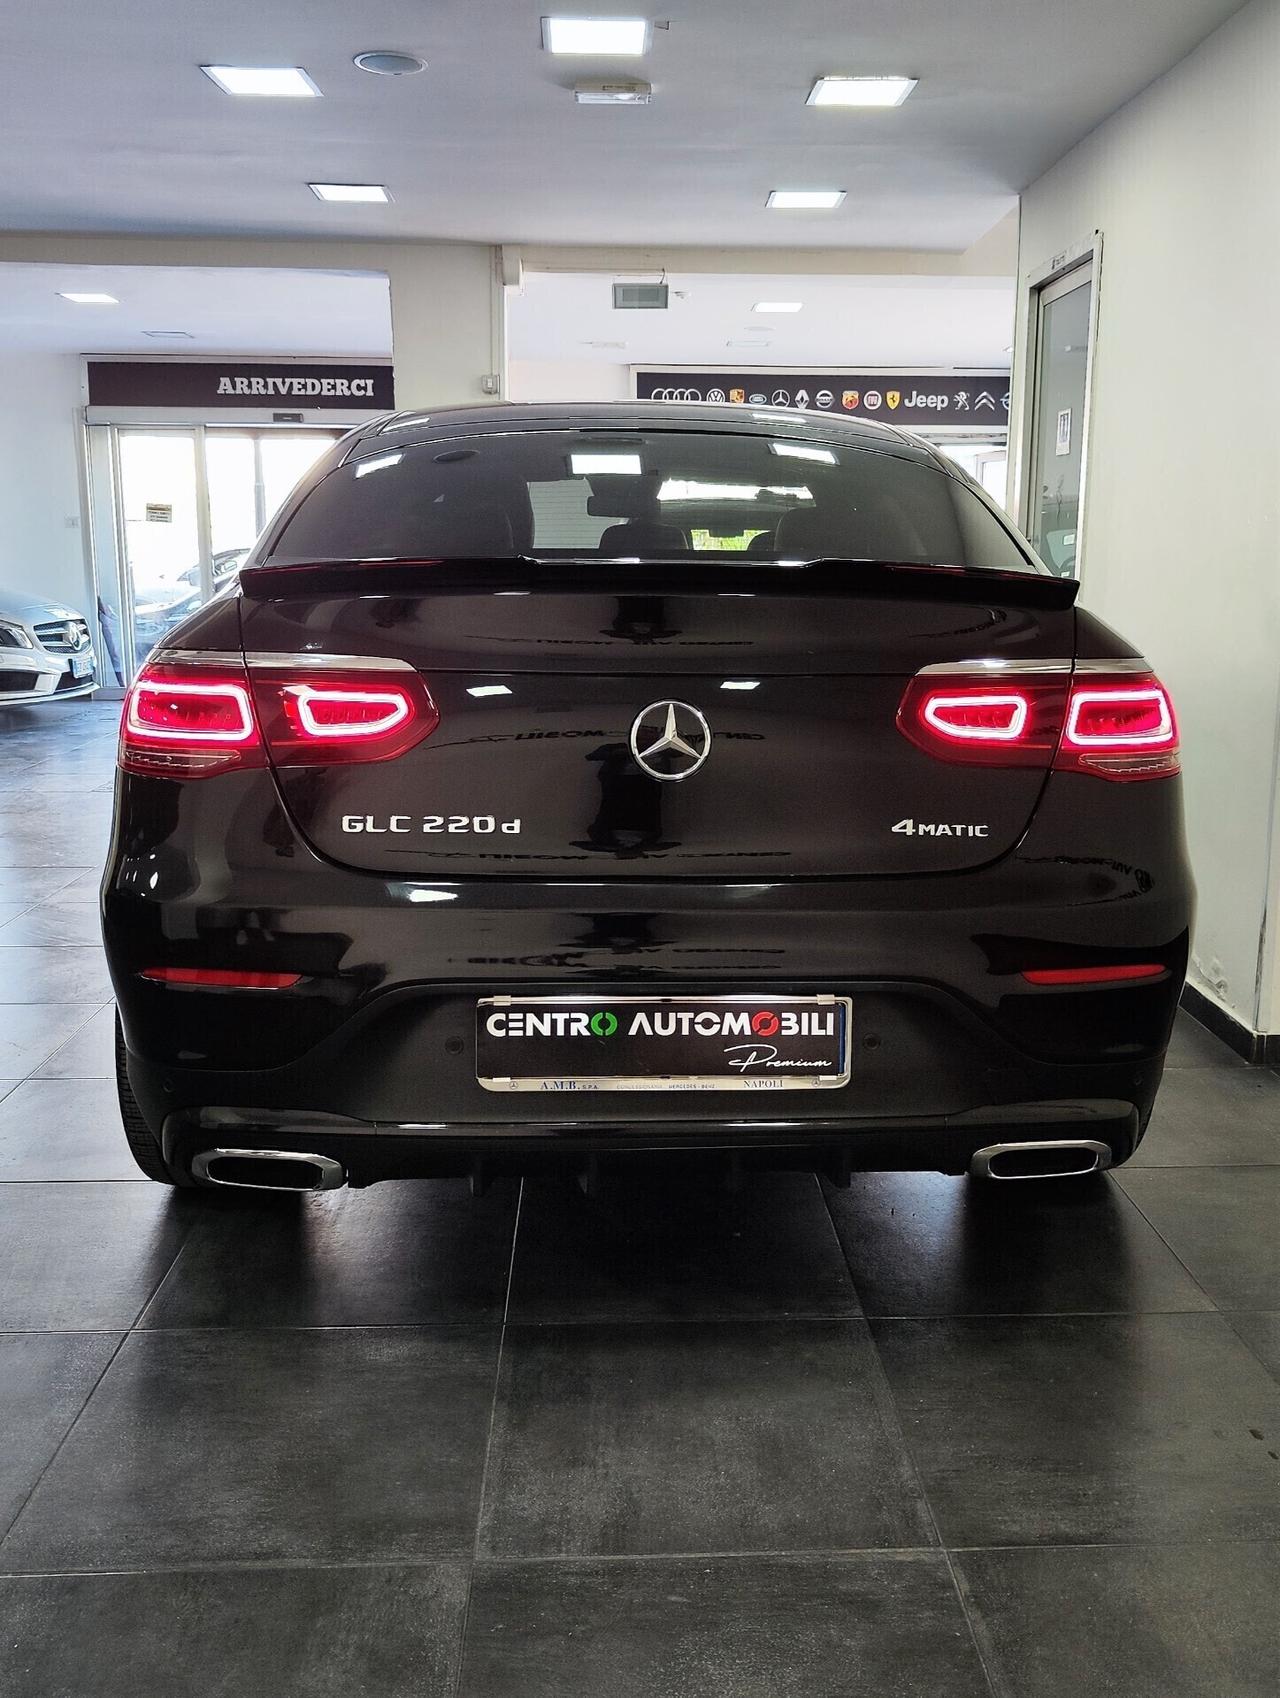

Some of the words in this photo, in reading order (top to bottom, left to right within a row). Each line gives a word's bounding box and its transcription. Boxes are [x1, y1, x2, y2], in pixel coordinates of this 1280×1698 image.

[217, 377, 374, 397] ARRIVEDERCI
[904, 391, 949, 411] Jeep
[341, 815, 412, 833] GLC
[486, 1012, 618, 1037] CENTRO
[628, 1010, 834, 1037] AUTOMOBILI
[723, 1044, 832, 1073] Premium
[743, 1081, 783, 1089] NAPOLI
